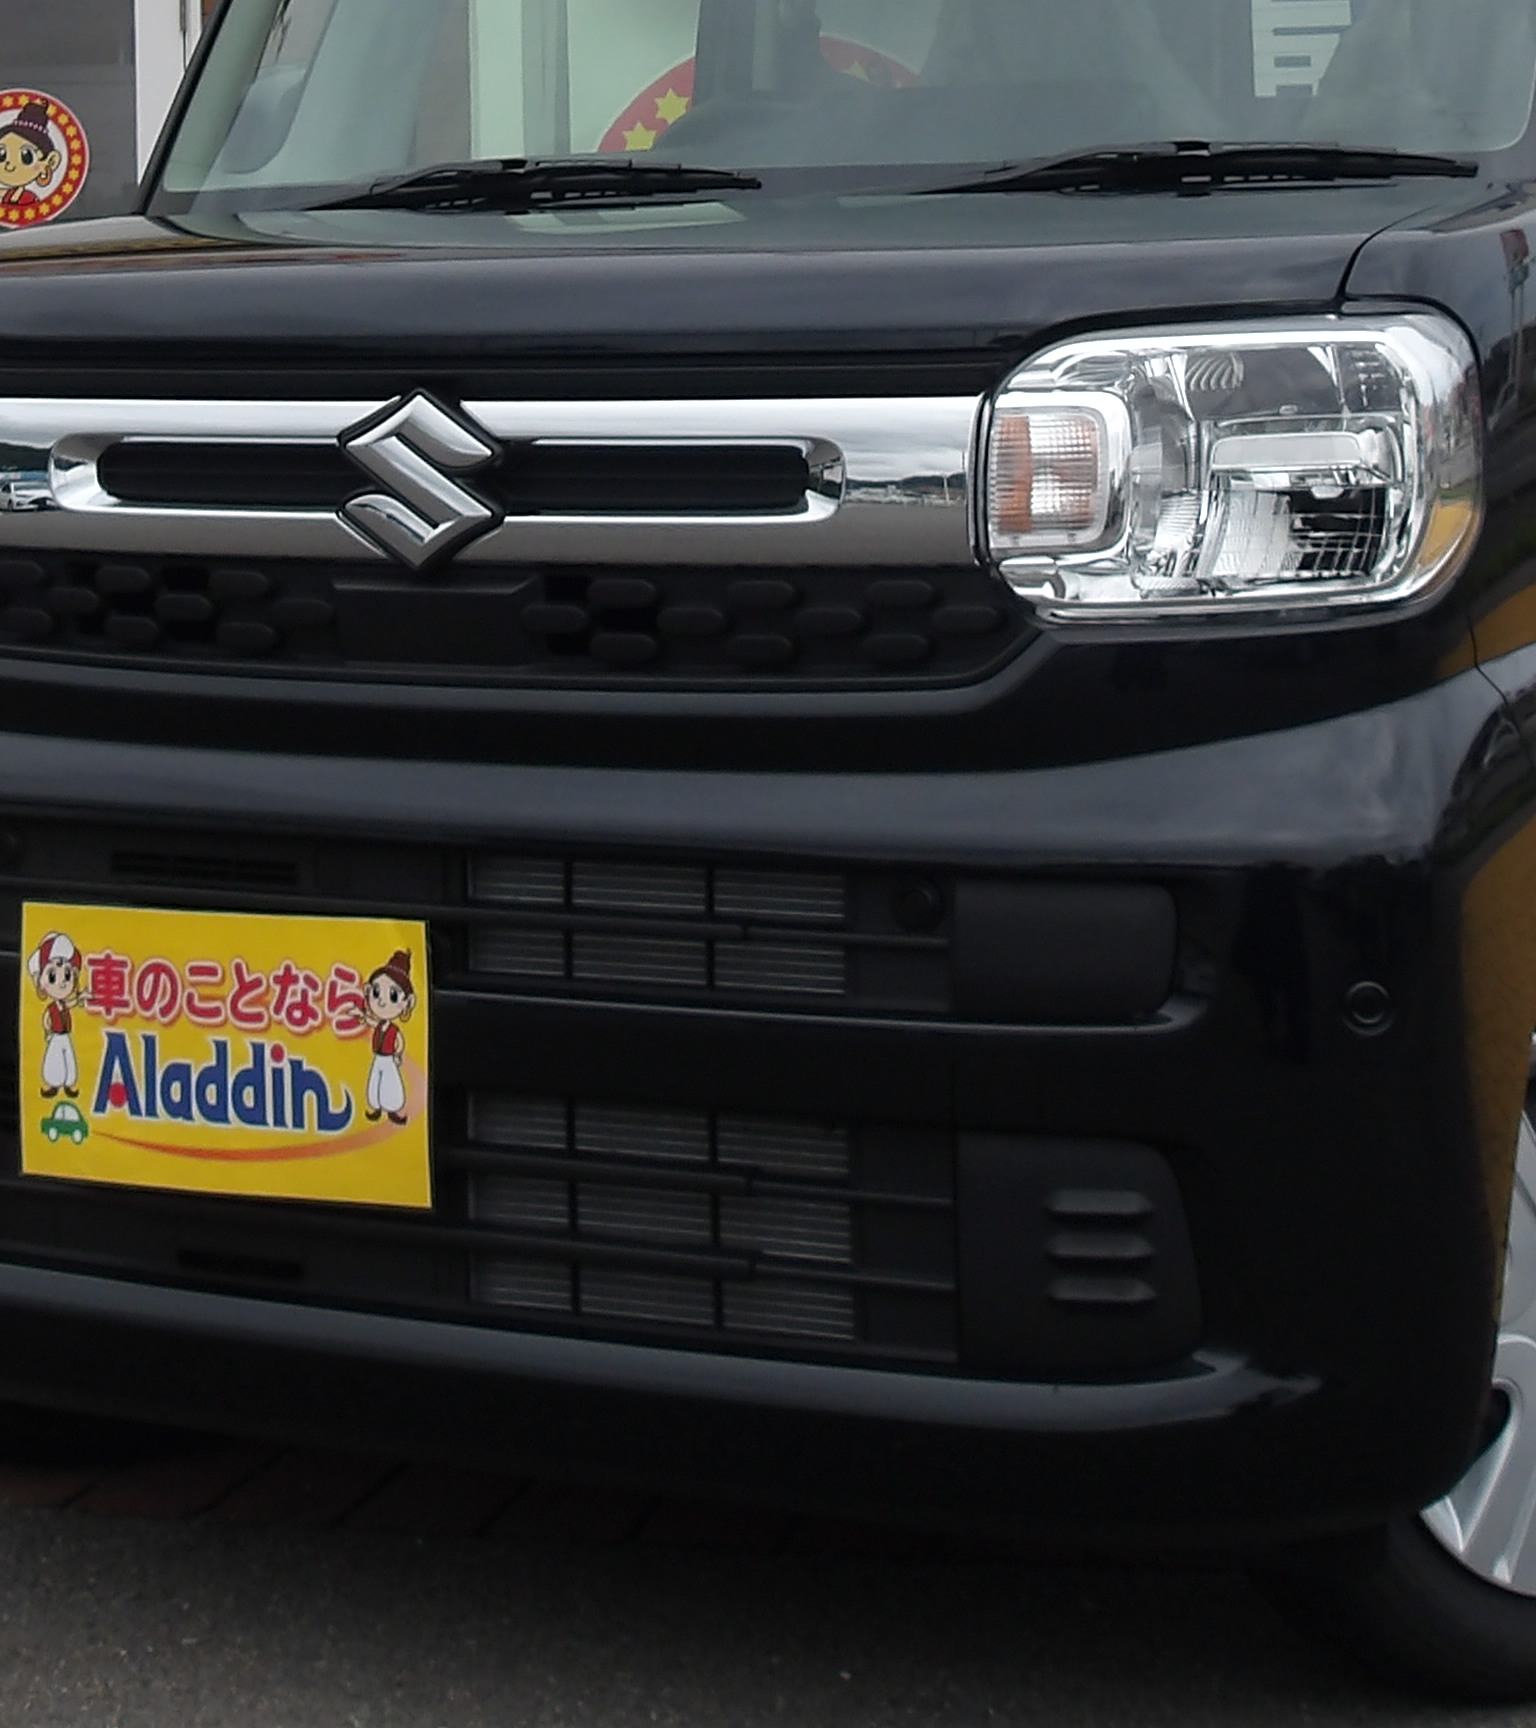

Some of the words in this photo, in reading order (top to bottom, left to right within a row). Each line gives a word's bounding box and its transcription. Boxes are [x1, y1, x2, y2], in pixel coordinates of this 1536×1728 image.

[85, 950, 368, 1035] 車のことなら
[91, 1029, 354, 1133] Aladdin
